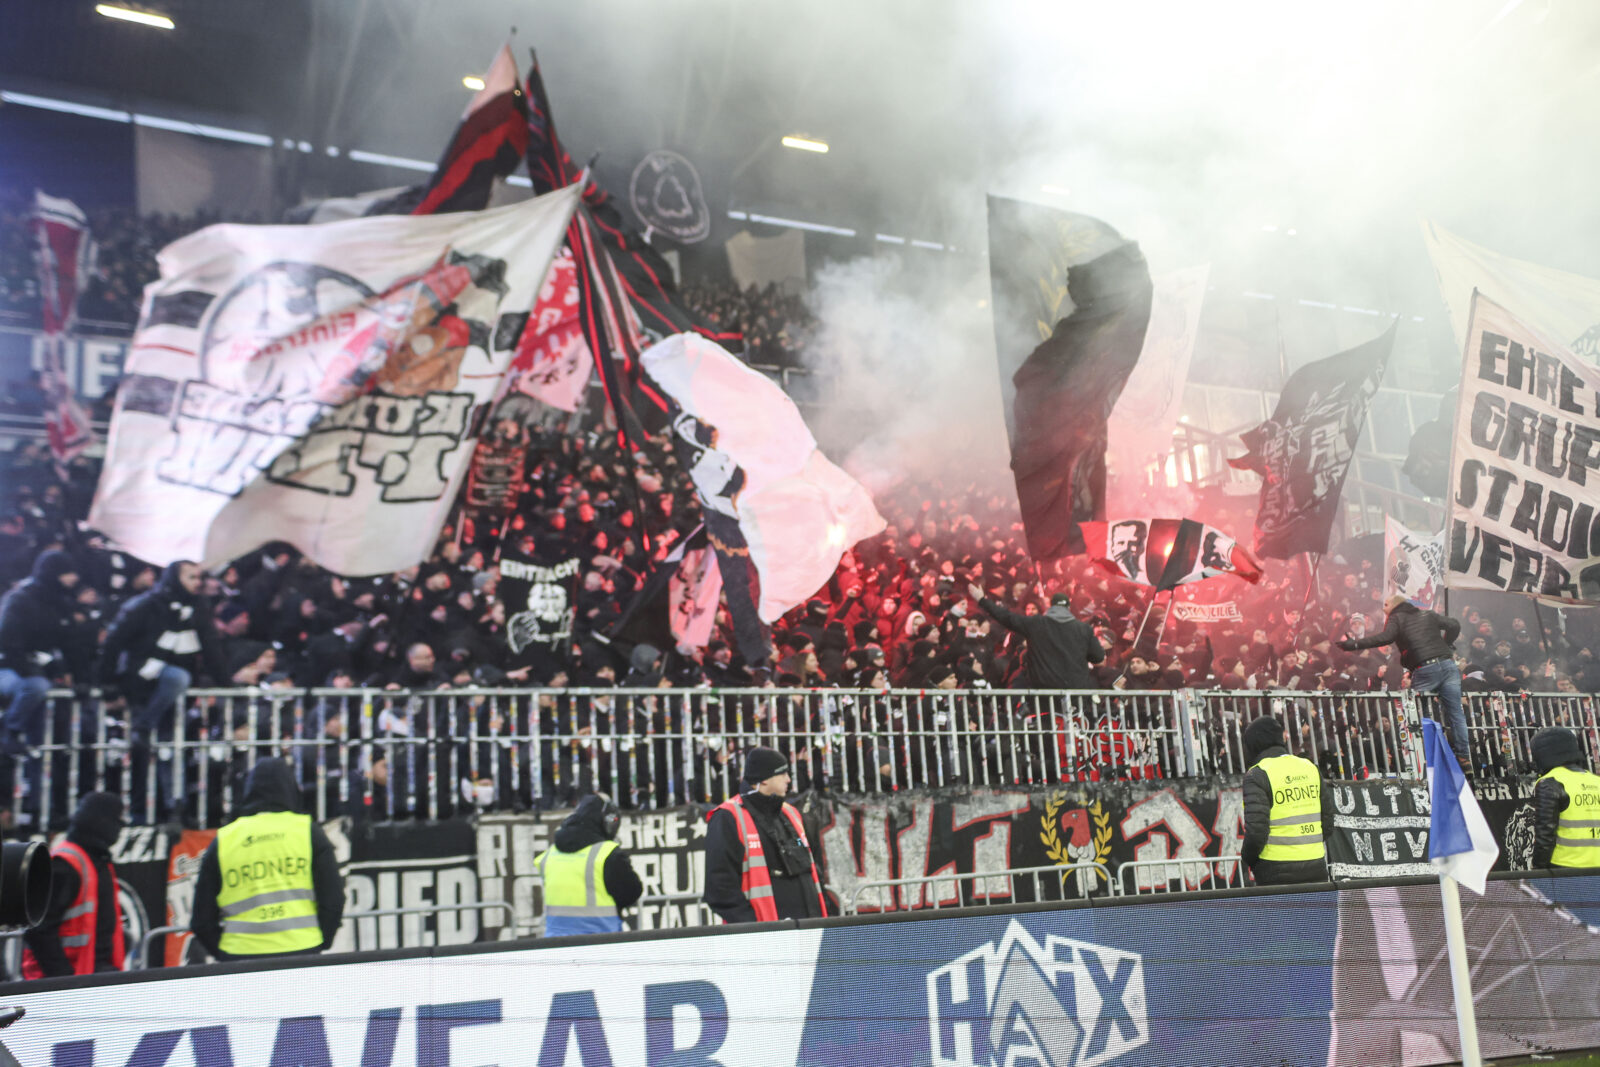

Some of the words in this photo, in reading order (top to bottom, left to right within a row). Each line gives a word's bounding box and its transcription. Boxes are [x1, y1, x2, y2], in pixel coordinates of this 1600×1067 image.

[1478, 330, 1585, 416] EHRE
[1333, 785, 1432, 815] ULTR
[615, 812, 688, 849] HRE
[1300, 824, 1314, 834] 360
[1352, 831, 1428, 861] NEV
[226, 857, 307, 888] ORDNER
